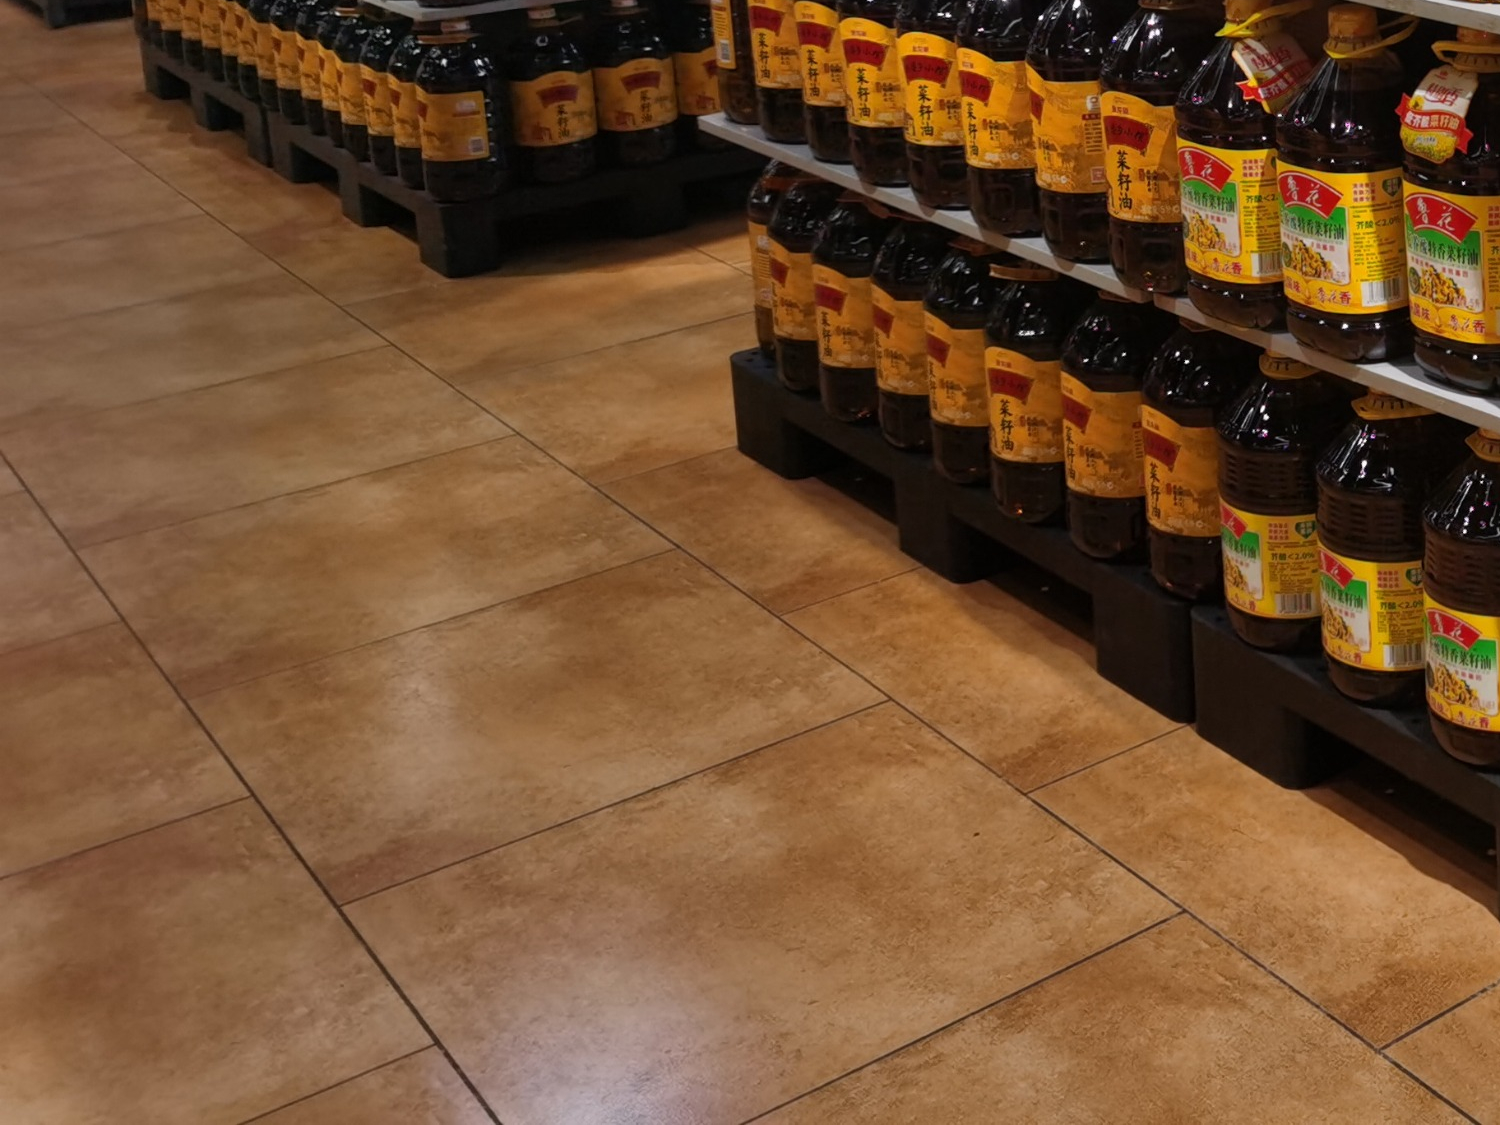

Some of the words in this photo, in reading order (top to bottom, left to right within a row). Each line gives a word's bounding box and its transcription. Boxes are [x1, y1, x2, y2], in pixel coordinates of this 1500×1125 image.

[917, 85, 934, 137] 菜籽油
[1116, 150, 1133, 211] 菜籽油
[1286, 175, 1323, 208] 鲁花
[1416, 197, 1455, 231] 鲁花
[998, 398, 1015, 452] 菜籽油
